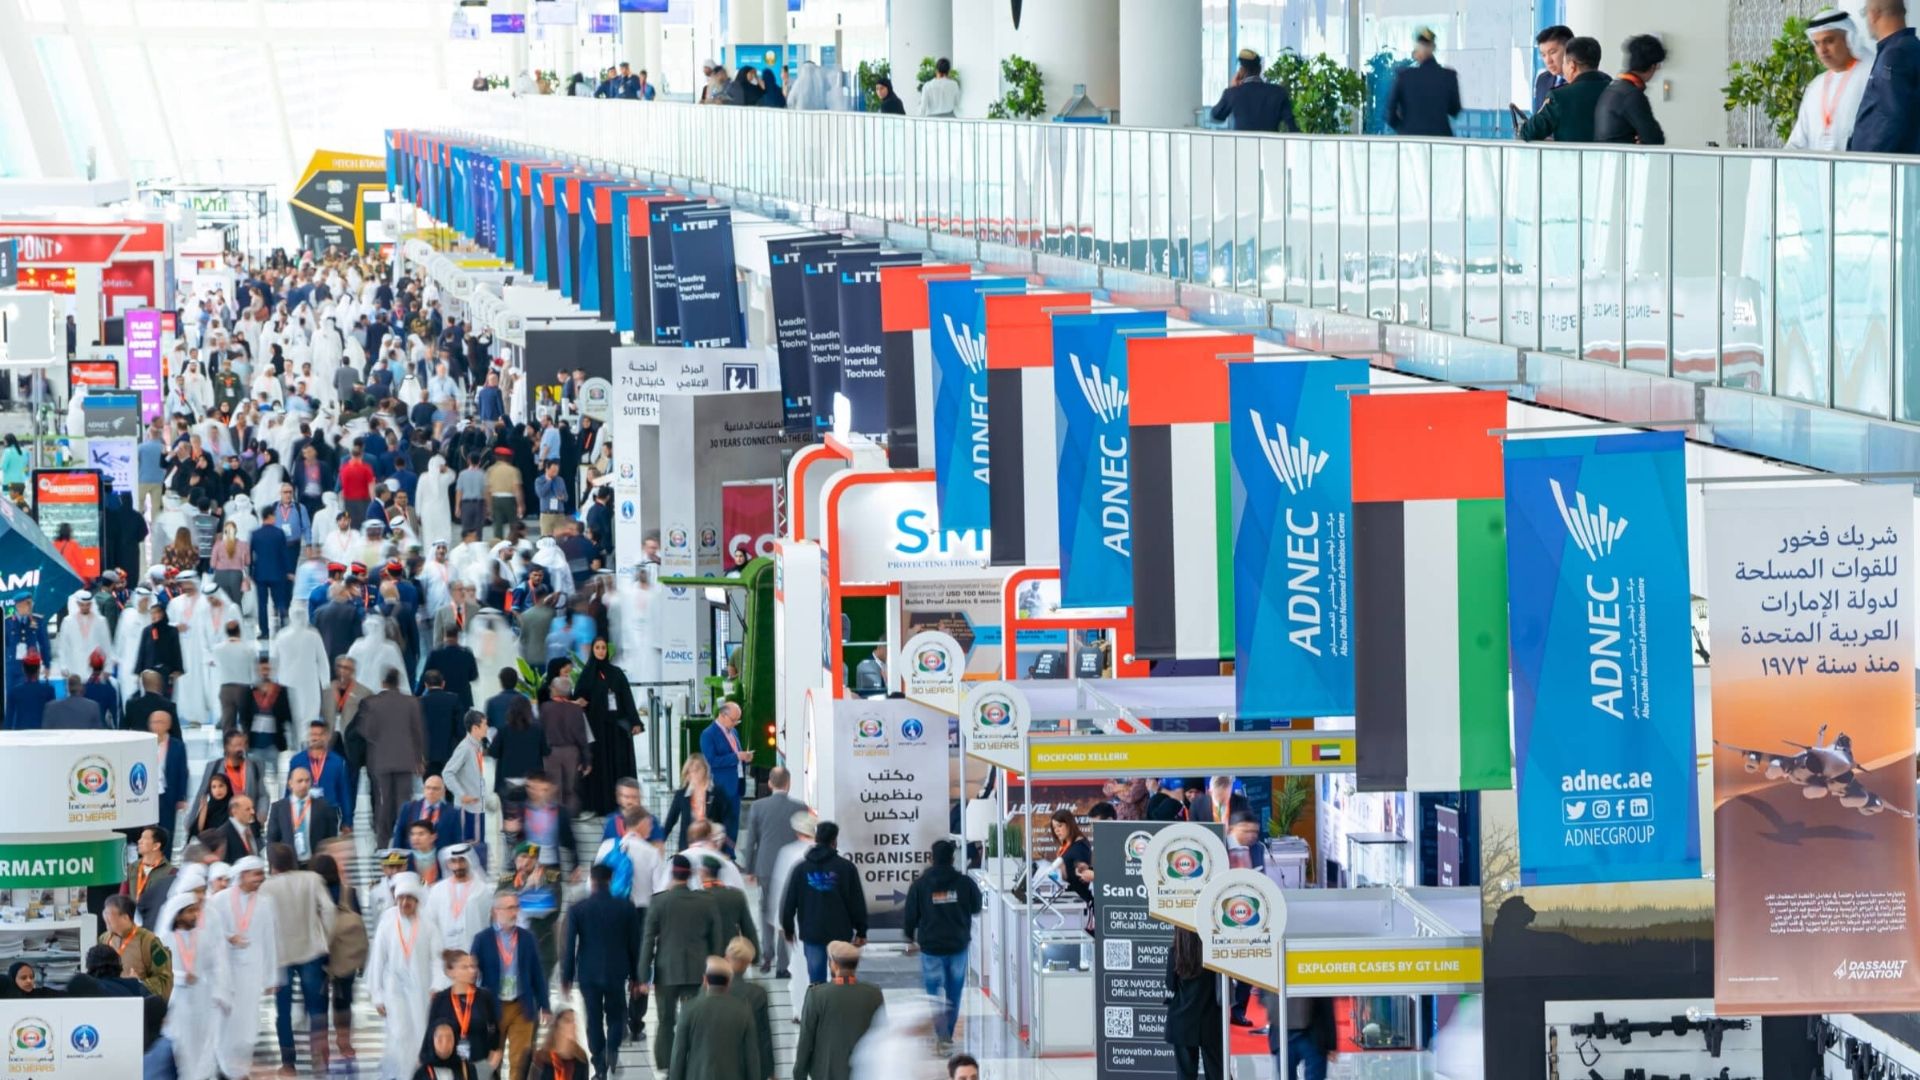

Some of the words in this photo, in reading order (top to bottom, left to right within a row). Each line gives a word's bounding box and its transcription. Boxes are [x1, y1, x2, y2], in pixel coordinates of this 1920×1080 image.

[673, 219, 718, 232] LITEF
[678, 274, 706, 284] Leading
[679, 284, 704, 292] Inertial
[680, 292, 720, 301] Technology
[684, 337, 731, 349] LITEF
[843, 344, 881, 354] Leading
[844, 356, 878, 366] Inertial
[681, 364, 704, 375] المركز
[626, 393, 659, 402] CAPITAL
[623, 406, 651, 416] SUITES
[720, 437, 741, 448] YEARS
[743, 433, 787, 447] CONNECTING
[789, 432, 800, 443] THE
[1100, 434, 1131, 557] ADNEC
[1778, 525, 1830, 553] فخور
[1836, 525, 1898, 551] شريك
[887, 560, 946, 569] PROTECTING
[1735, 558, 1824, 581] المسلحة
[1831, 555, 1898, 583] للقوات
[1286, 508, 1321, 657] ADNEC
[1761, 589, 1839, 618] الإمارات
[1846, 588, 1898, 614] لدولة
[1741, 622, 1822, 645] المتحدة
[1829, 619, 1899, 647] العربية
[1587, 573, 1624, 721] ADNEC
[664, 651, 693, 660] ADNEC
[1762, 656, 1809, 676] ١٩٧٢
[1816, 655, 1857, 674] سنة
[1864, 655, 1900, 673] منذ
[925, 686, 955, 694] YEARS
[973, 742, 985, 750] 30
[988, 741, 1019, 750] YEARS
[1037, 752, 1086, 762] ROCKFORD
[1088, 751, 1129, 761] XELLERIX
[868, 769, 914, 784] مكتب
[1561, 769, 1653, 792] adnec.ae
[860, 788, 923, 803] منظمين
[874, 833, 910, 846] IDEX
[1565, 825, 1655, 847] ADNECGROUP
[0, 857, 94, 878] RMATION
[865, 869, 920, 882] OFFICE
[1103, 884, 1133, 897] Scan
[1110, 912, 1128, 920] IDEX
[1129, 912, 1147, 920] 2023
[1110, 921, 1137, 929] Official
[1138, 921, 1158, 930] Show
[1138, 946, 1168, 954] NAVDEX
[1212, 949, 1229, 959] 30
[1230, 948, 1272, 958] YEARS
[1138, 955, 1164, 964] Official
[1297, 962, 1356, 974] EXPLORER
[1359, 961, 1395, 973] CASES
[1398, 961, 1412, 972] BY
[1415, 961, 1431, 972] GT
[1433, 960, 1460, 971] LINE
[1849, 960, 1907, 971] DASSAULT
[1848, 970, 1903, 980] AVIATION
[1111, 979, 1128, 988] IDEX
[1130, 980, 1160, 988] NAVDEX
[1111, 988, 1137, 997] Official
[1139, 989, 1163, 998] Pocket
[1139, 1015, 1156, 1023] IDEX
[1139, 1024, 1165, 1033] Mobile
[1112, 1047, 1152, 1056] Innovation
[1112, 1057, 1135, 1065] Guide
